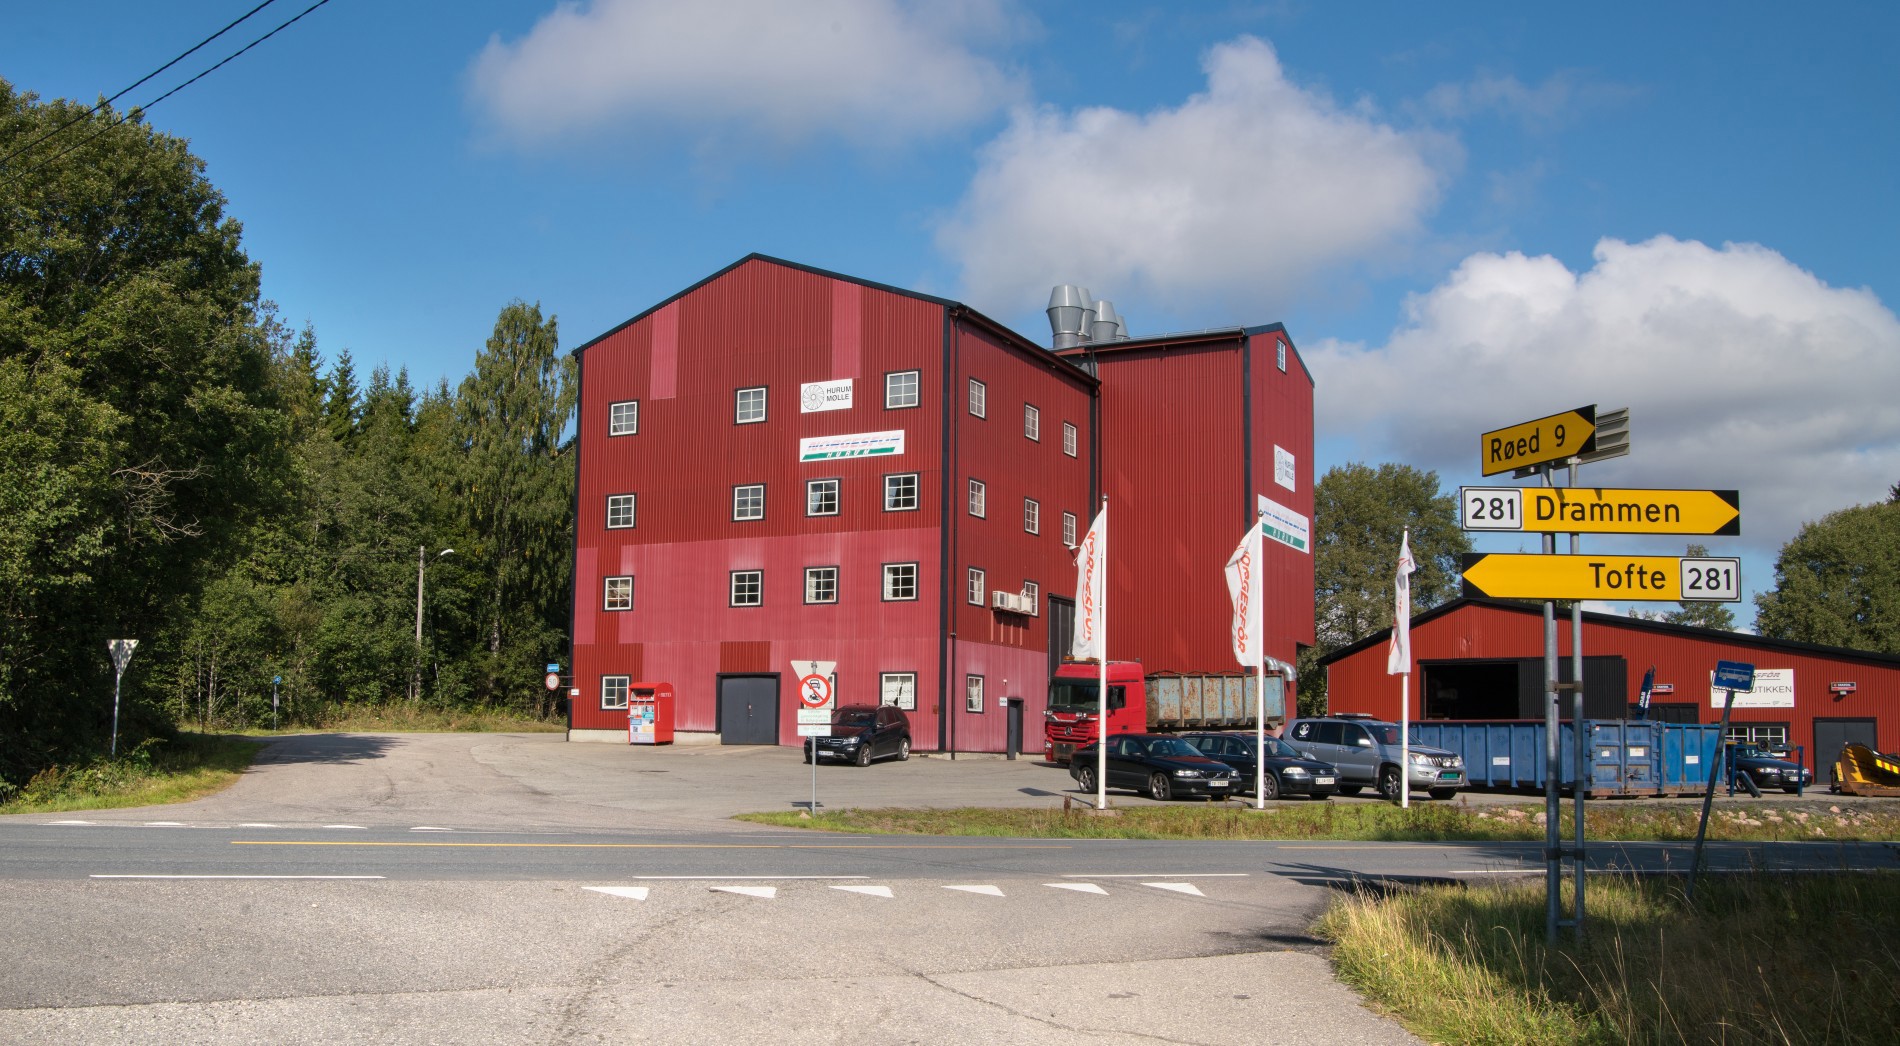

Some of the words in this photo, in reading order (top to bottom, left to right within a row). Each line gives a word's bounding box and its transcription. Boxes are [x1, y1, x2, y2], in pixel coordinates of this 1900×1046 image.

[827, 386, 852, 394] HURUM
[826, 448, 871, 458] HURUM
[1490, 427, 1540, 464] Røed
[1554, 424, 1566, 448] 9
[1470, 497, 1515, 521] 281
[1536, 495, 1680, 523] Drammen
[1589, 562, 1666, 589] Tofte
[1688, 567, 1732, 591] 281
[1237, 550, 1251, 654] ORGESFÔR
[549, 678, 557, 687] 50
